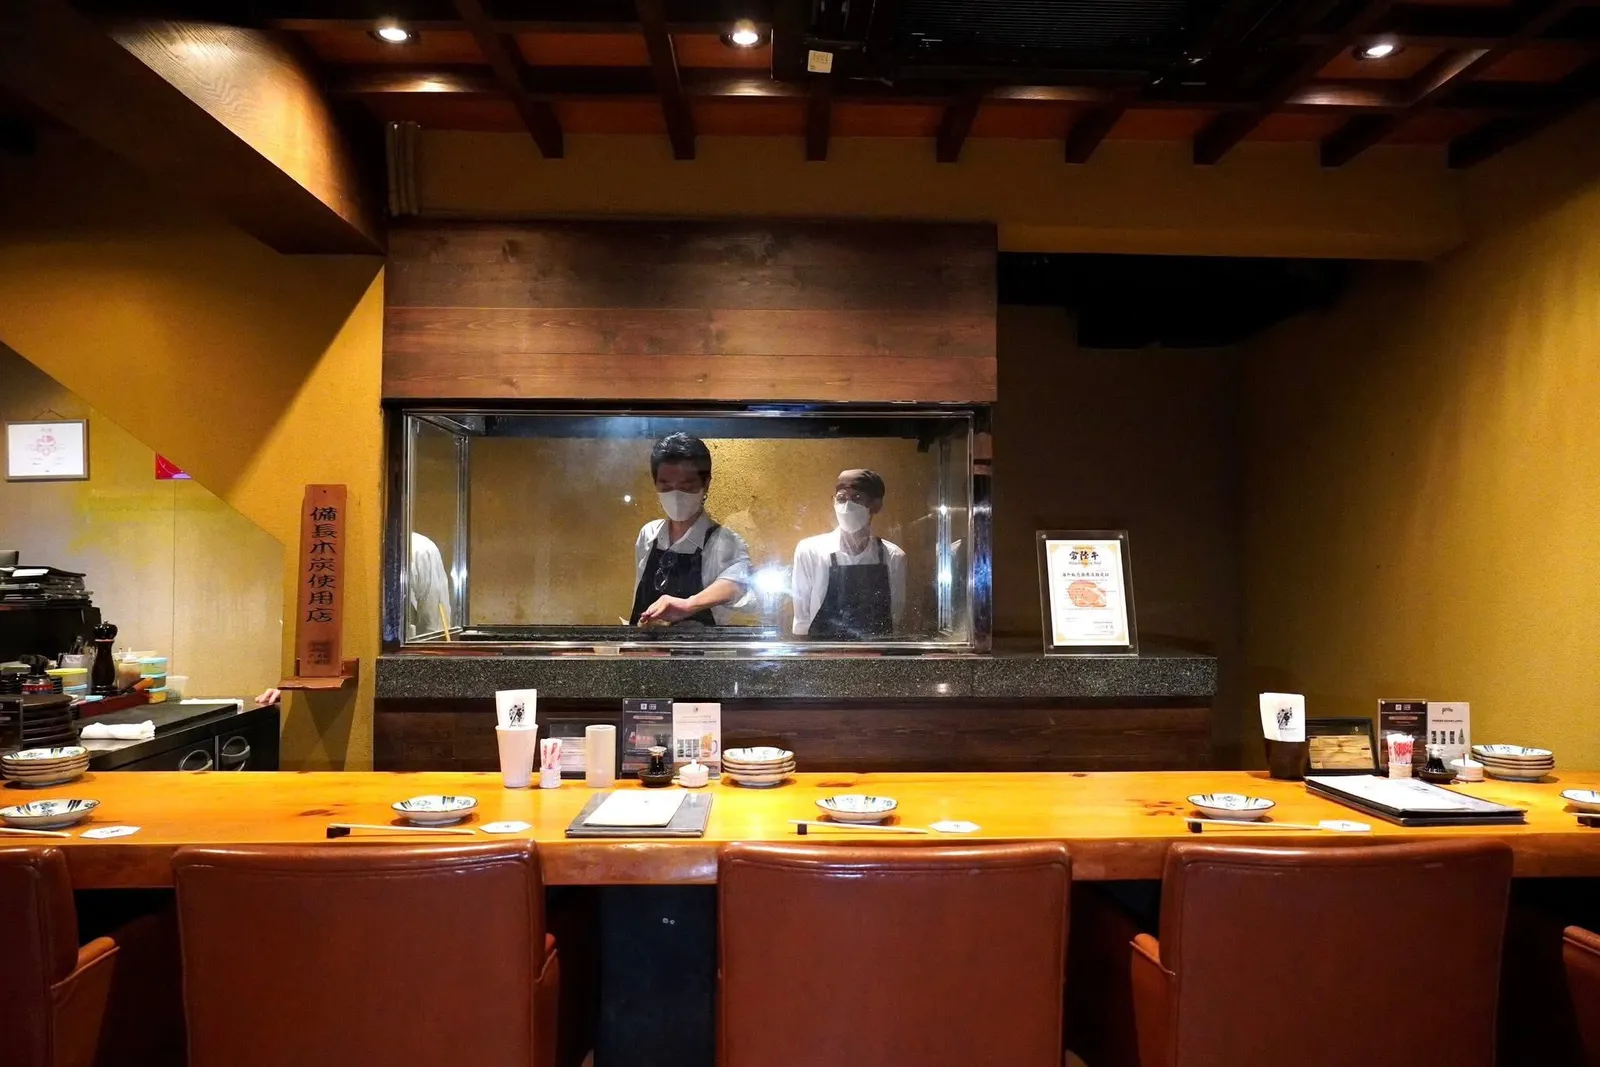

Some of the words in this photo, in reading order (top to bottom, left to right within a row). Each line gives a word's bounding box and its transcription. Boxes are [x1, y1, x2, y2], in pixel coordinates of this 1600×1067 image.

[306, 506, 337, 622] 備長木炭使用店
